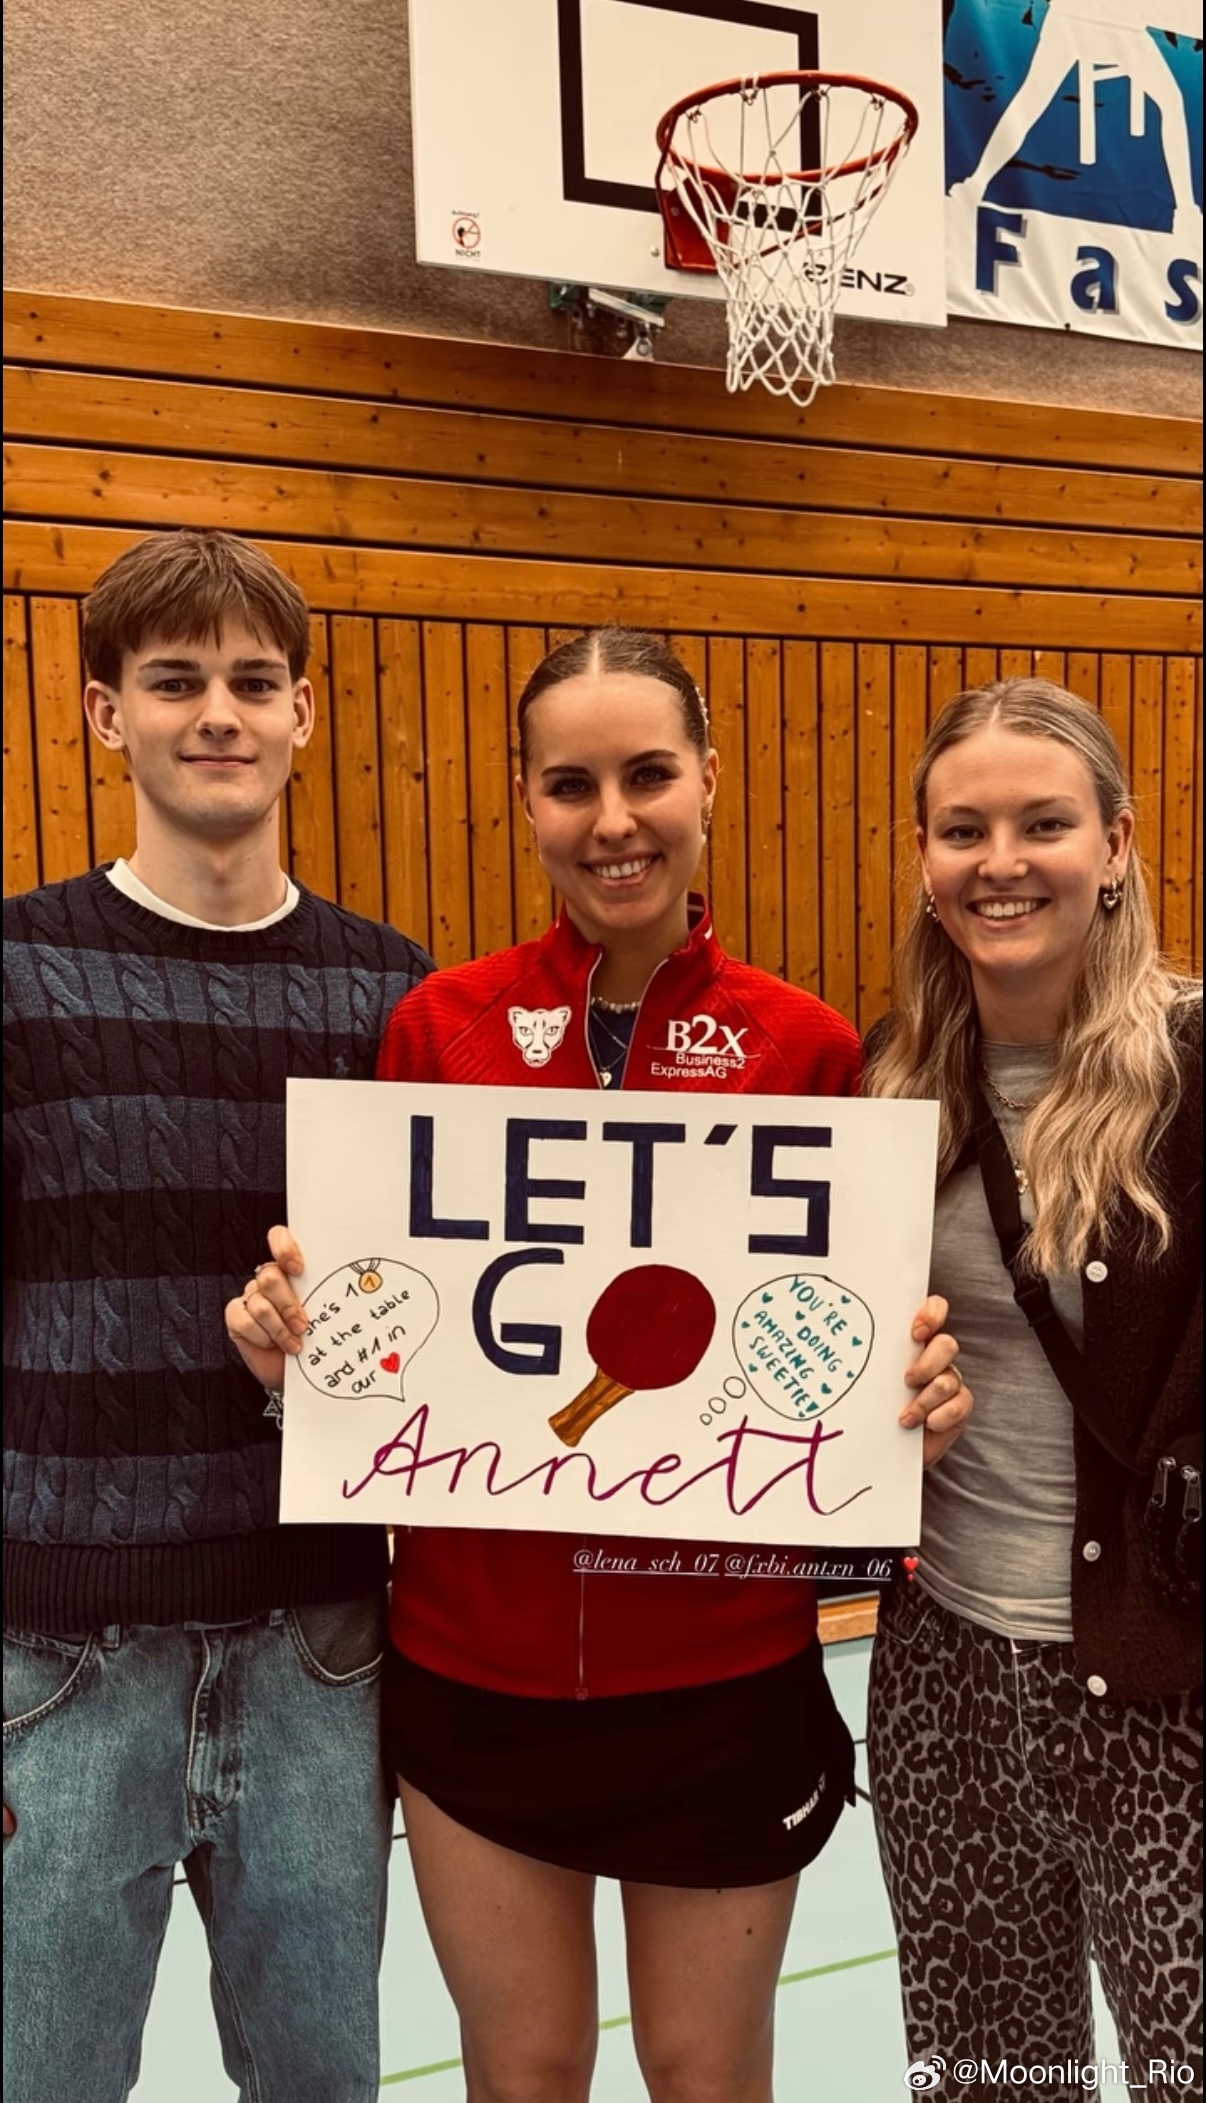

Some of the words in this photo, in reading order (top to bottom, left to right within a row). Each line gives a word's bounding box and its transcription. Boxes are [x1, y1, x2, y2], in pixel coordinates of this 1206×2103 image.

[409, 1115, 832, 1257] LET'S
[308, 1346, 327, 1366] at
[330, 1323, 363, 1347] the
[370, 1290, 410, 1320] table
[789, 1275, 848, 1336] YOU'RE
[324, 1361, 355, 1388] and
[387, 1325, 406, 1342] in
[753, 1310, 815, 1379] AMAZING
[796, 1325, 843, 1372] DOING
[351, 1370, 376, 1393] our
[343, 1403, 873, 1515] Annett
